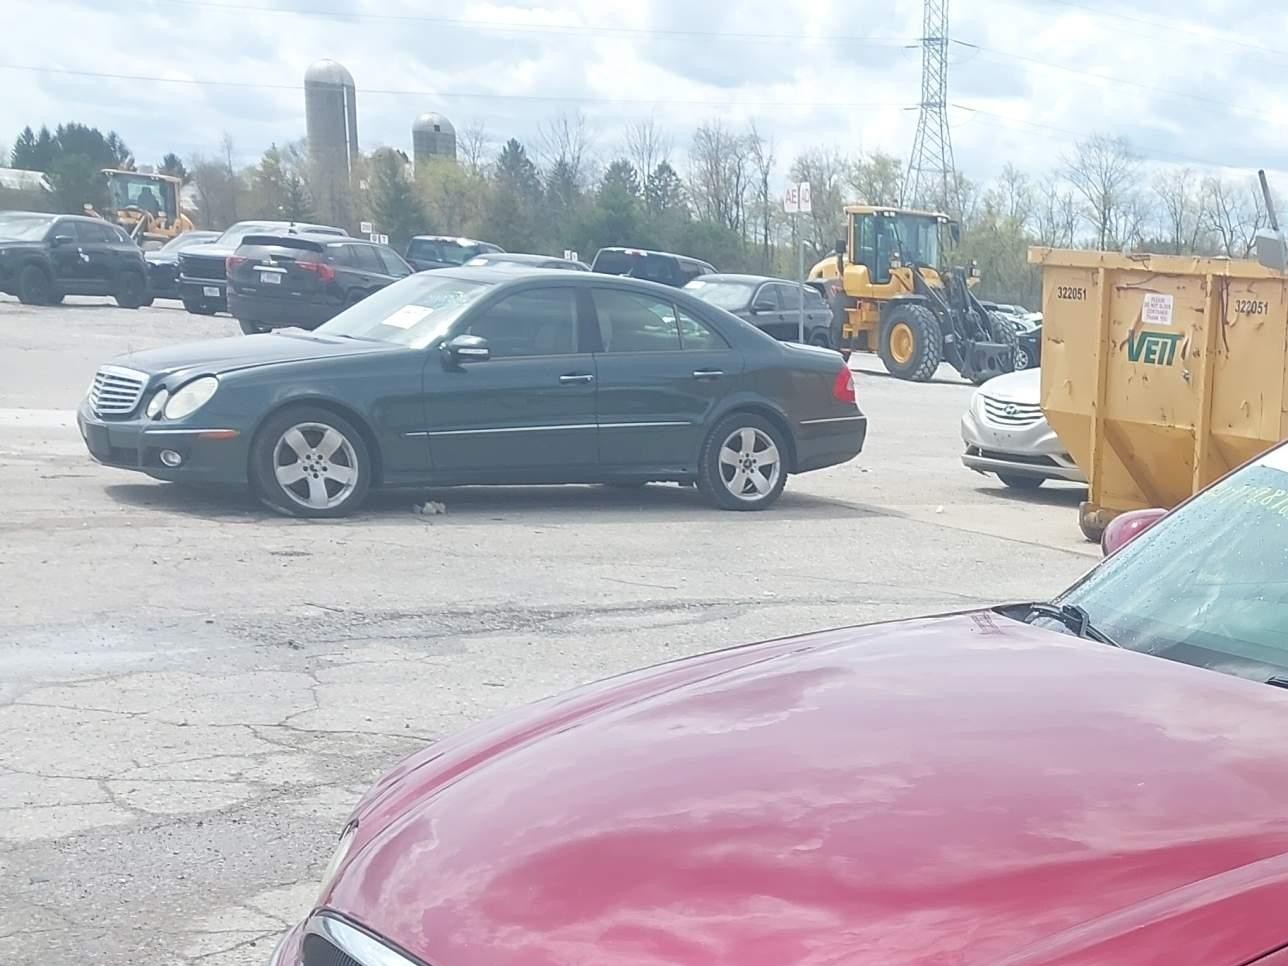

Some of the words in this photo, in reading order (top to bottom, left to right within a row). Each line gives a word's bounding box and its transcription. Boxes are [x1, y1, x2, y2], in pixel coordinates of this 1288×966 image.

[1057, 286, 1087, 300] 322051
[1234, 299, 1269, 315] 322051
[1127, 330, 1185, 367] VEIT
